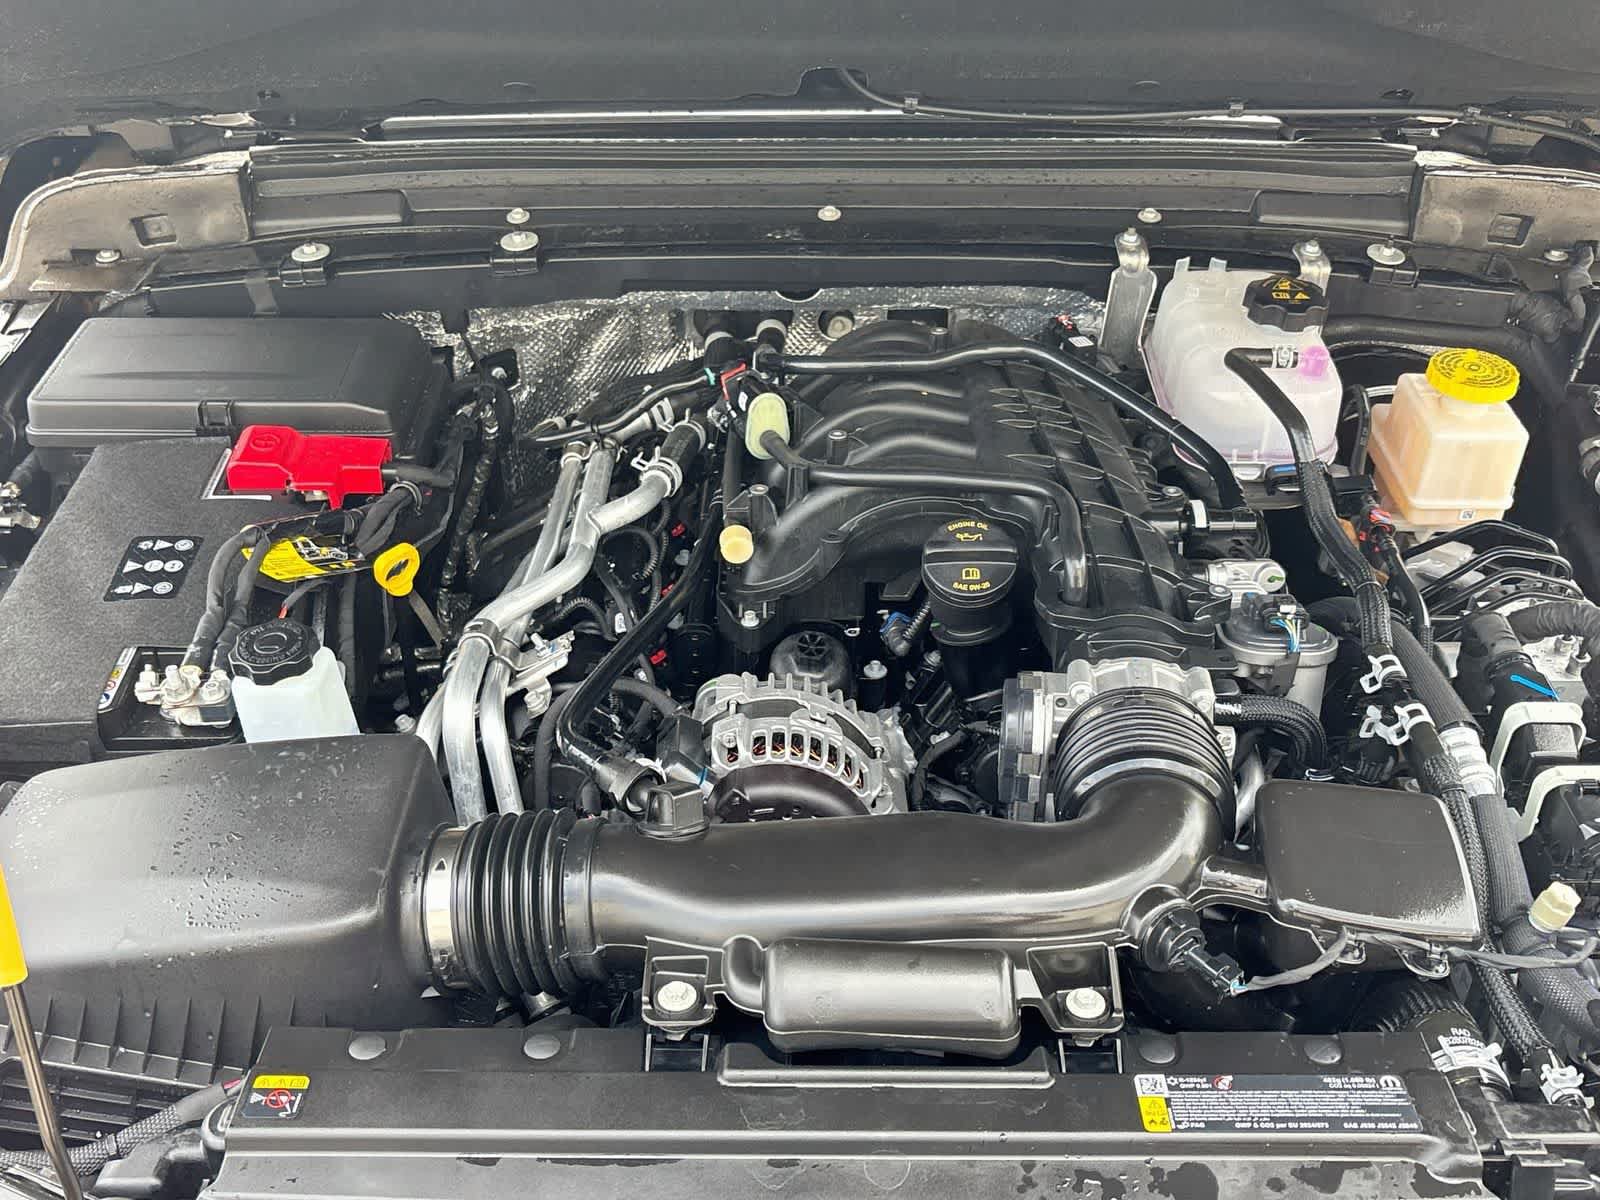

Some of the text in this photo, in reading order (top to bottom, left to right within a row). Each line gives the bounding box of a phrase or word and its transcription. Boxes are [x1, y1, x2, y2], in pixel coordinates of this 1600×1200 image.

[947, 521, 991, 531] ENGINE OIL
[952, 581, 969, 591] SAE
[1450, 1027, 1471, 1037] RAD
